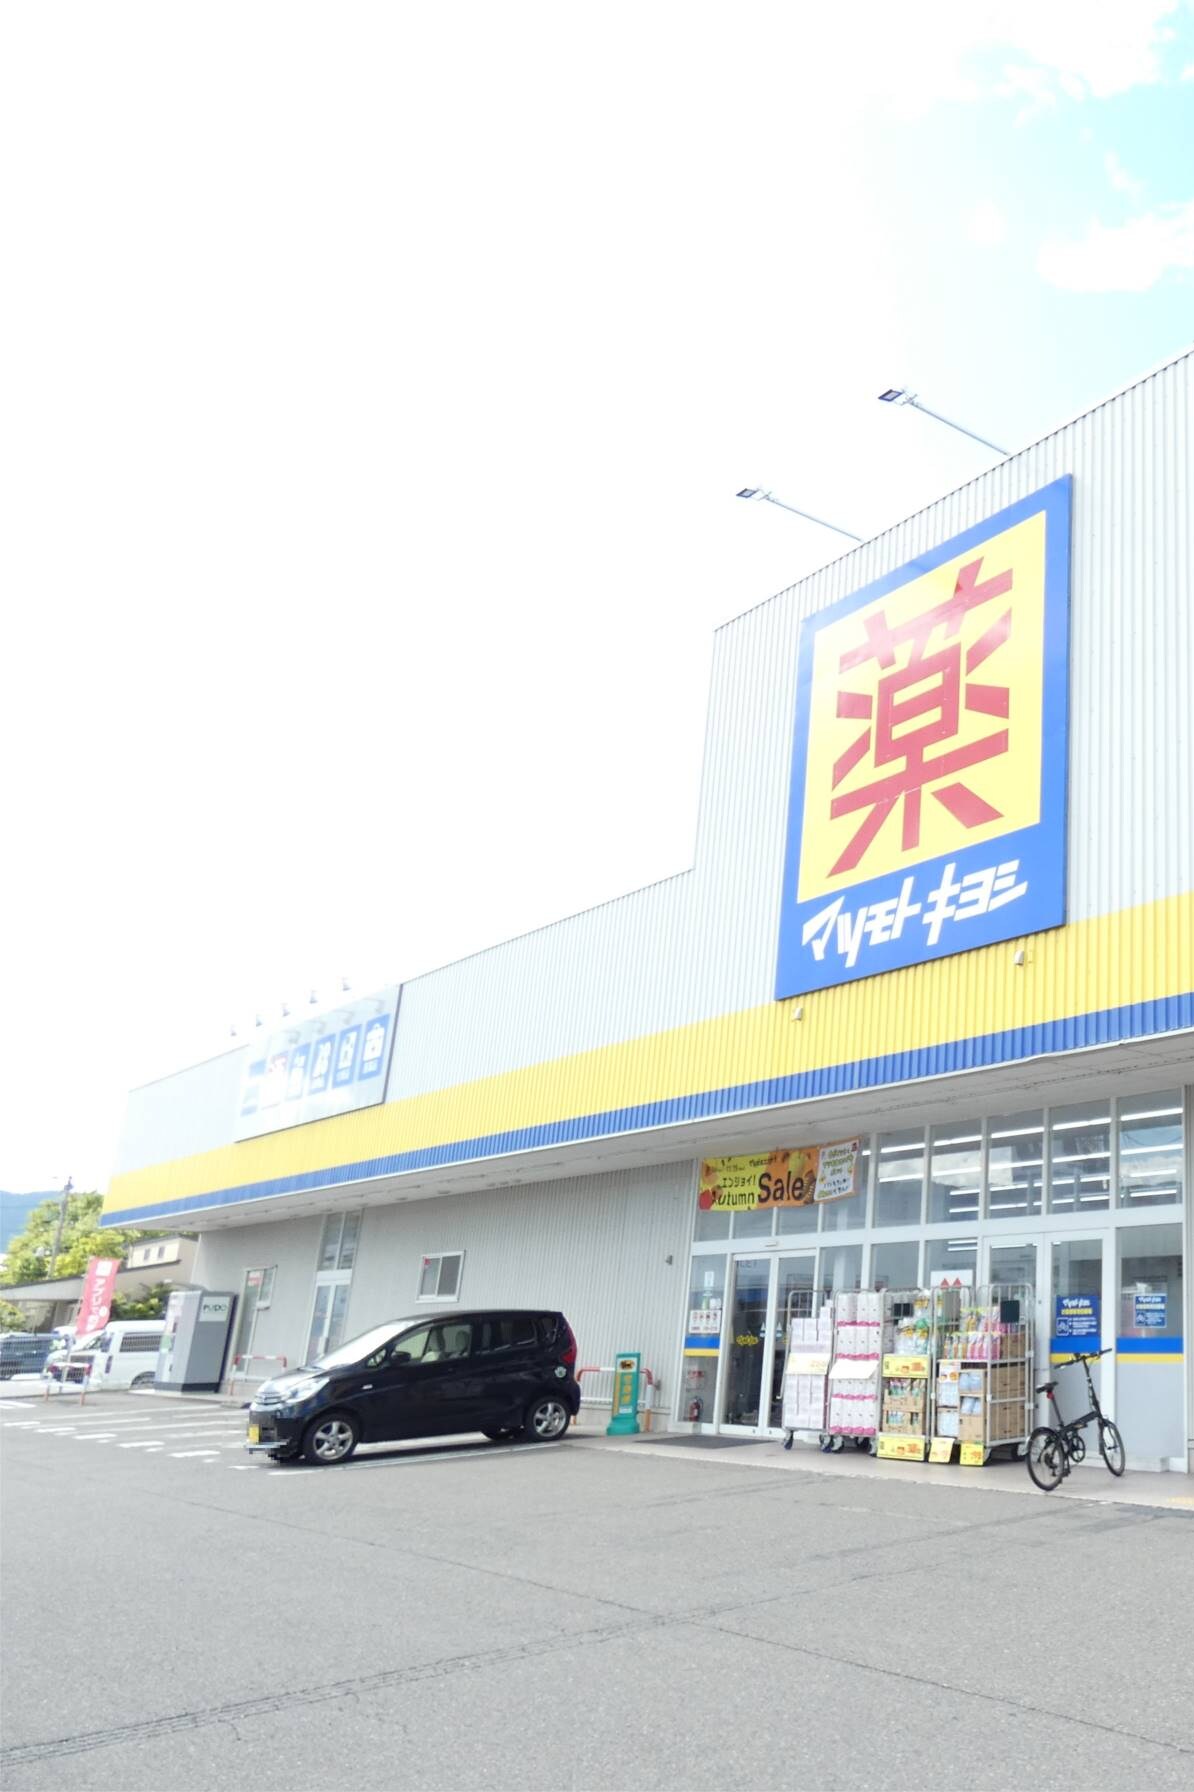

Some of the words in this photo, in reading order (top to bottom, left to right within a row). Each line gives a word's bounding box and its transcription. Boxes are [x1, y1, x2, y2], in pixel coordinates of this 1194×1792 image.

[826, 556, 1013, 878] 薬
[802, 857, 1028, 968] マツモトキヨシ
[758, 1170, 804, 1203] Sale
